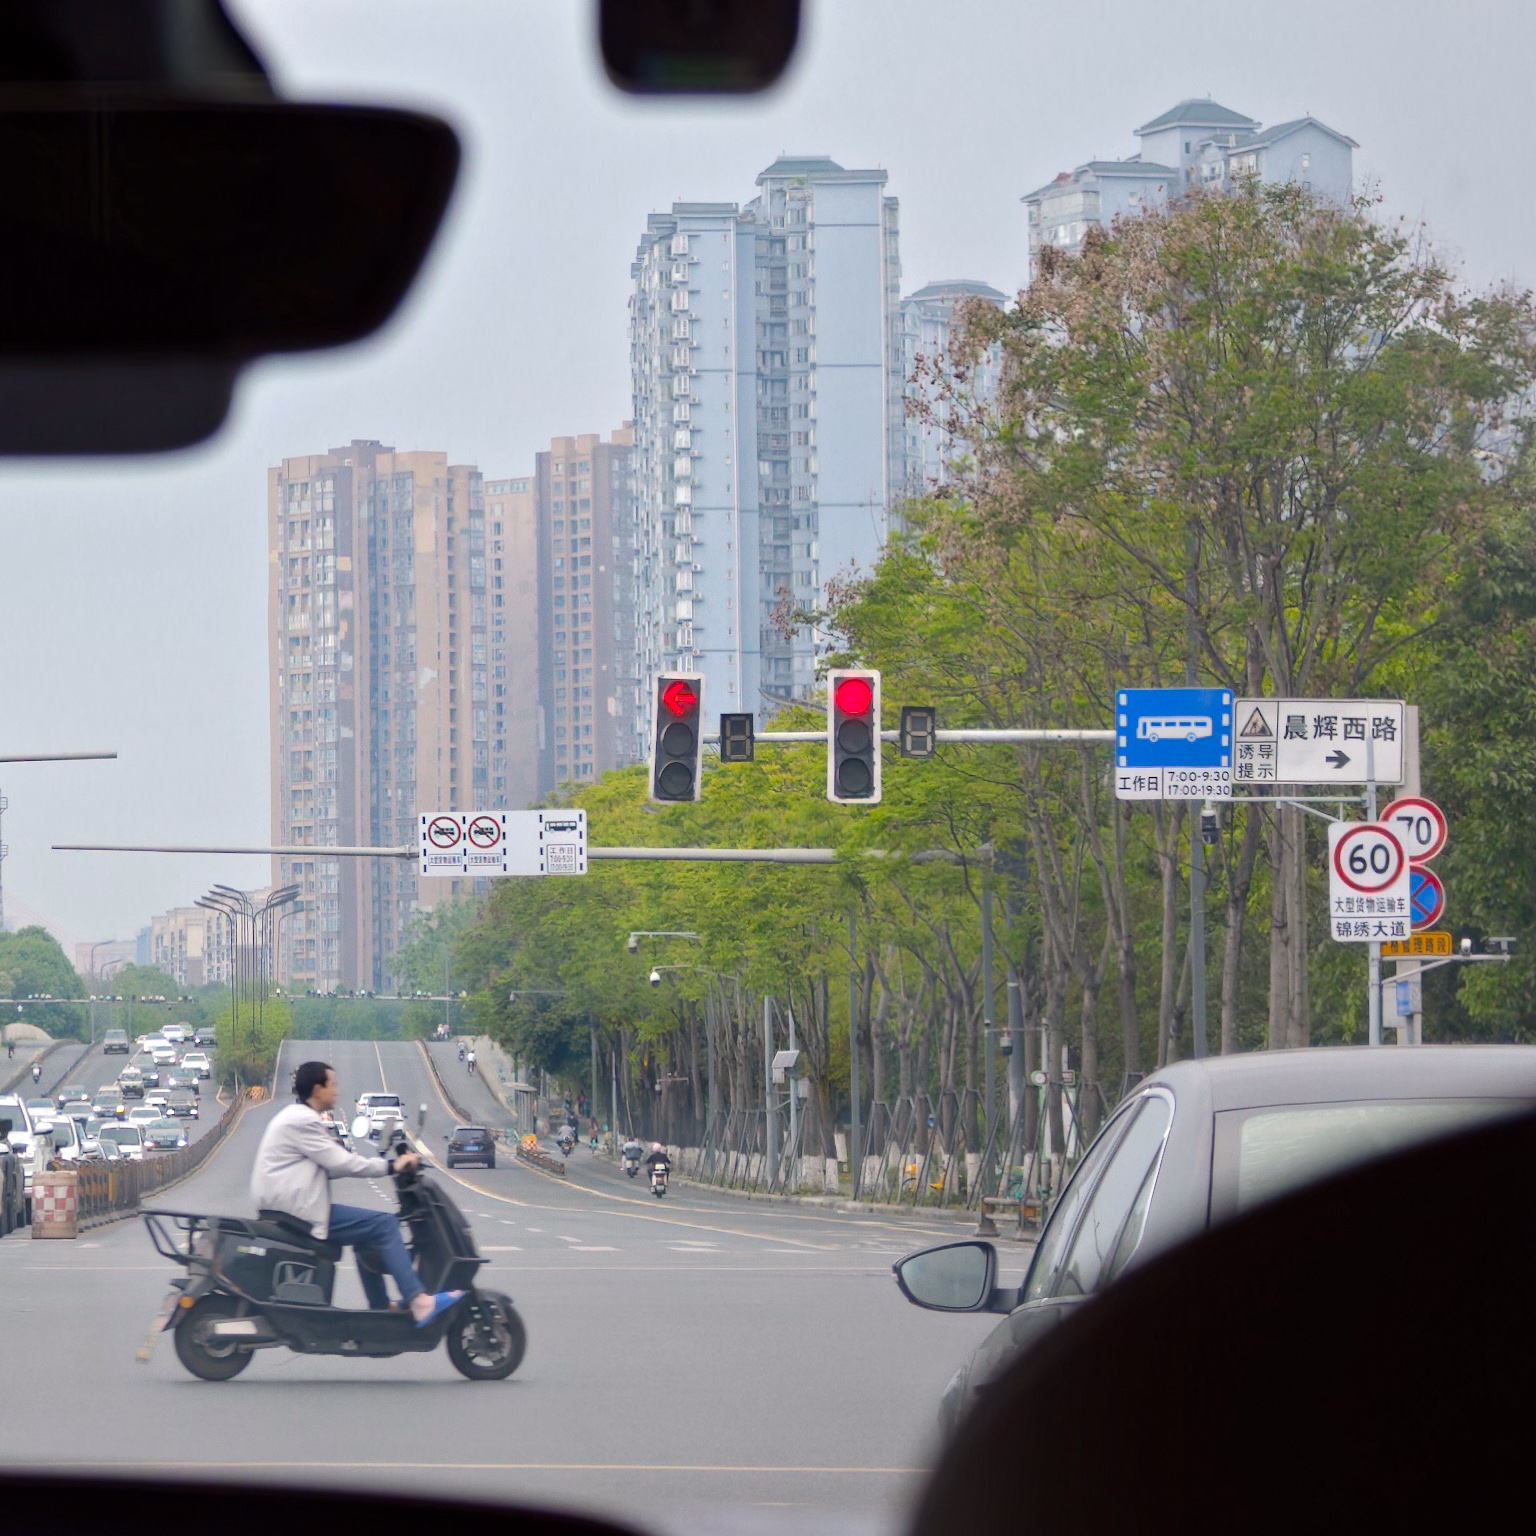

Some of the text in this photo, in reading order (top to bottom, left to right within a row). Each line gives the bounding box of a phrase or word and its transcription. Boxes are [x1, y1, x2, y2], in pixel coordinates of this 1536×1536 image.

[1283, 715, 1397, 741] 晨辉西路
[1238, 744, 1274, 760] 诱导
[1168, 771, 1230, 782] 7:00-9:30
[1238, 763, 1274, 779] 提示
[1119, 775, 1158, 792] 工作日
[1168, 784, 1230, 795] 17:00-19:30
[1349, 844, 1390, 874] 60
[1335, 897, 1405, 913] 大型货物运输车
[1336, 921, 1406, 937] 锦绣大道
